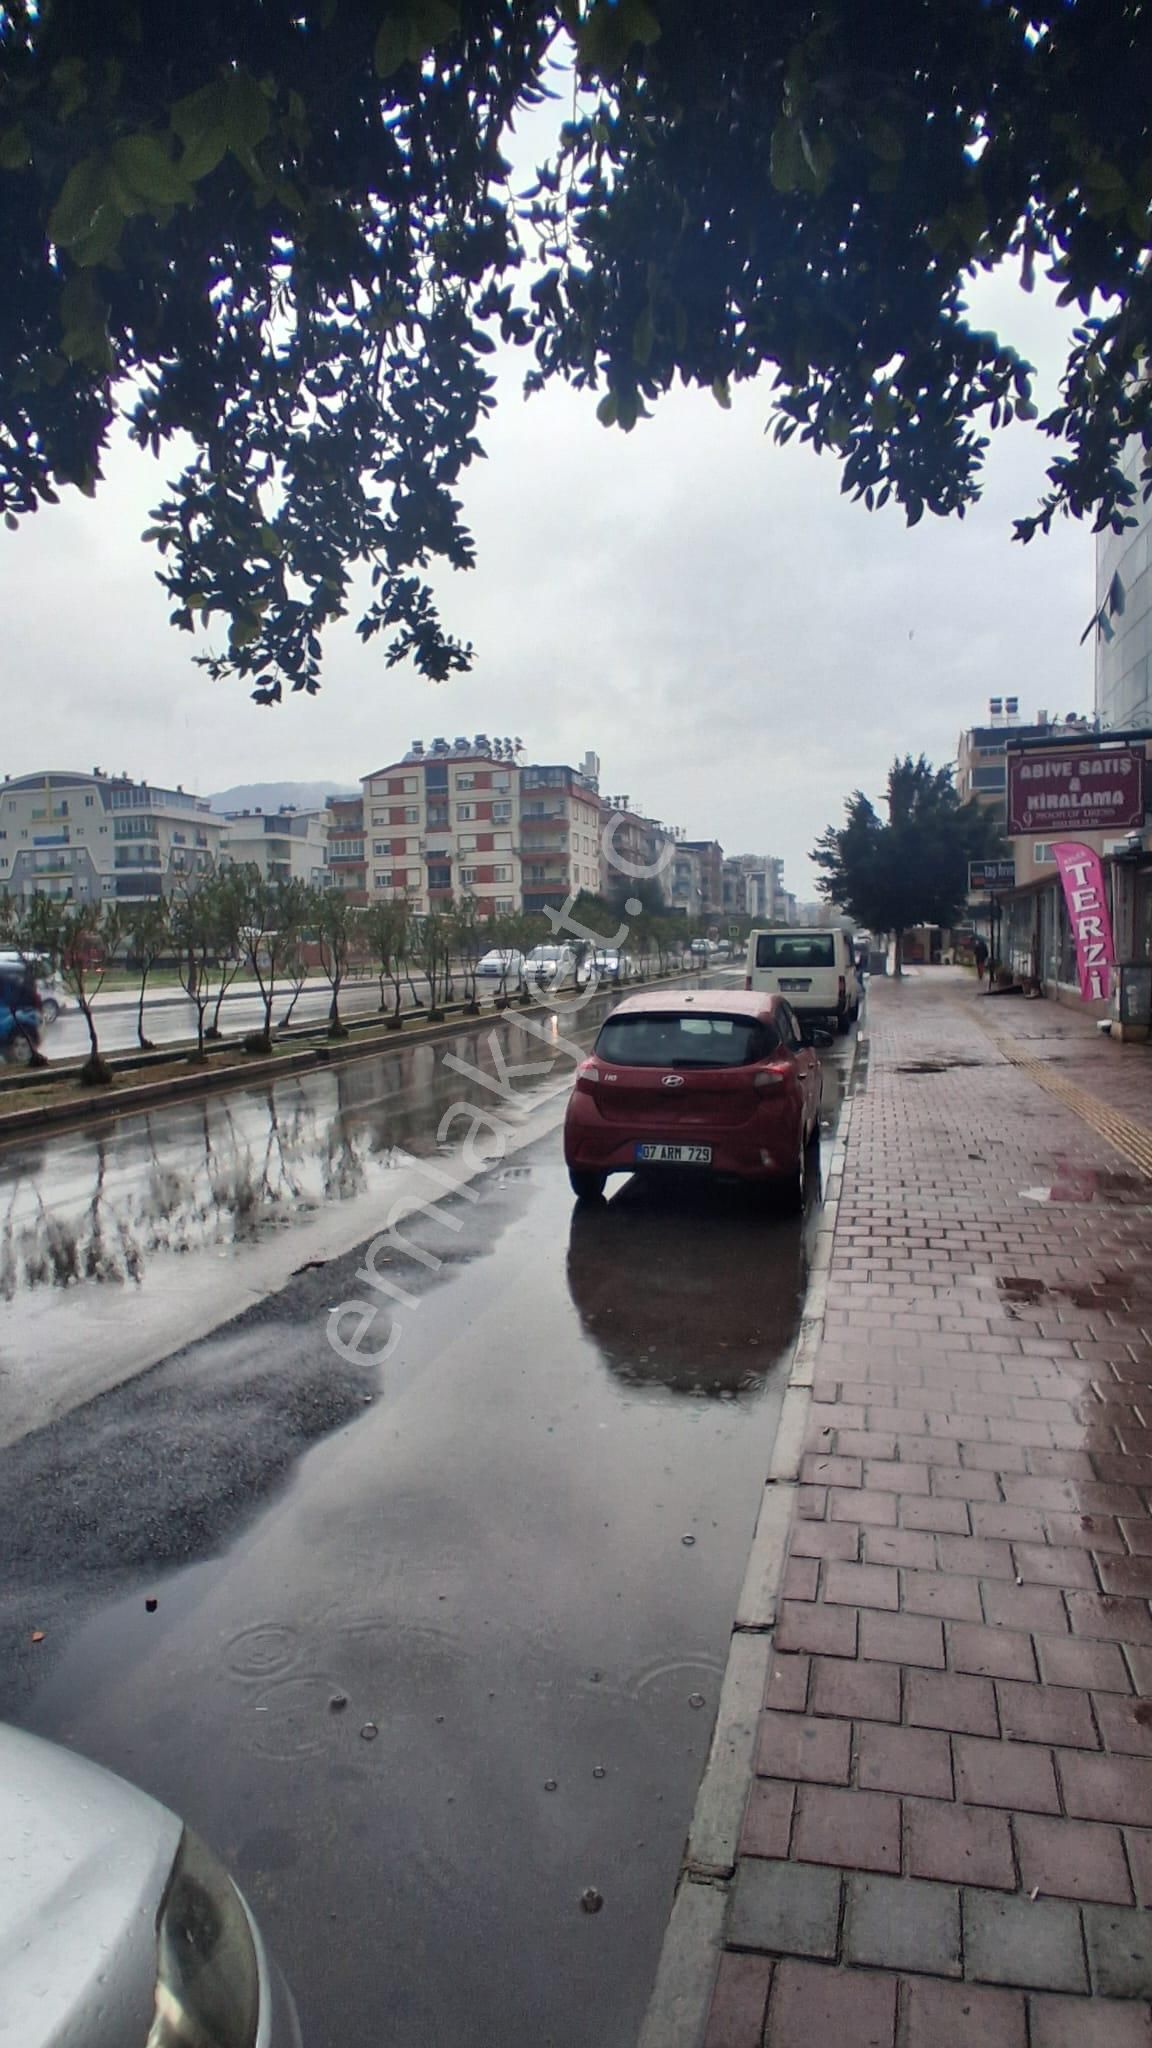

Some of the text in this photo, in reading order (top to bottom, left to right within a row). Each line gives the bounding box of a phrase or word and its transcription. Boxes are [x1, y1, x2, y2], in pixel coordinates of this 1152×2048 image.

[1020, 758, 1132, 779] ABİYE SATIŞ
[1069, 777, 1081, 791] &
[1027, 790, 1124, 810] KİRALAMA
[1065, 861, 1107, 1000] TERZİ
[660, 1146, 682, 1160] ARM
[688, 1148, 710, 1161] 729
